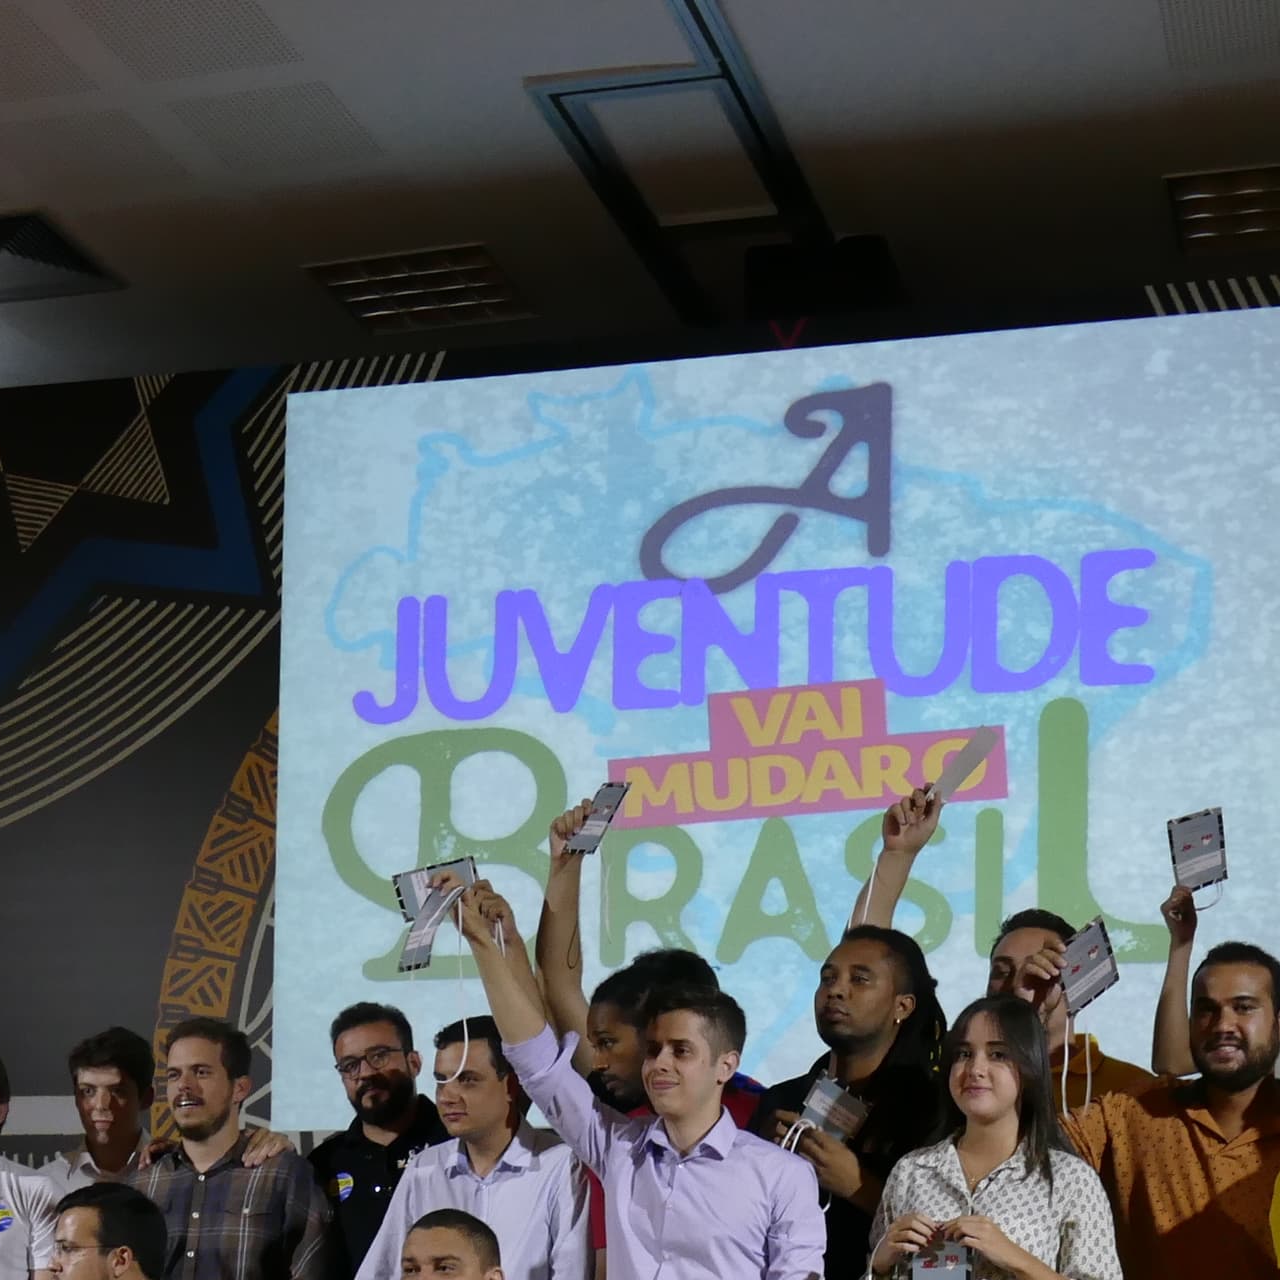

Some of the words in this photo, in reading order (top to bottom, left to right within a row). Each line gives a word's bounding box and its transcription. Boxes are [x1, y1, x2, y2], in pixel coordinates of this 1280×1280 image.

[639, 381, 892, 593] A
[352, 549, 1156, 725] JUVENTUDE
[731, 686, 864, 749] VAI
[322, 697, 1168, 982] BRASIL
